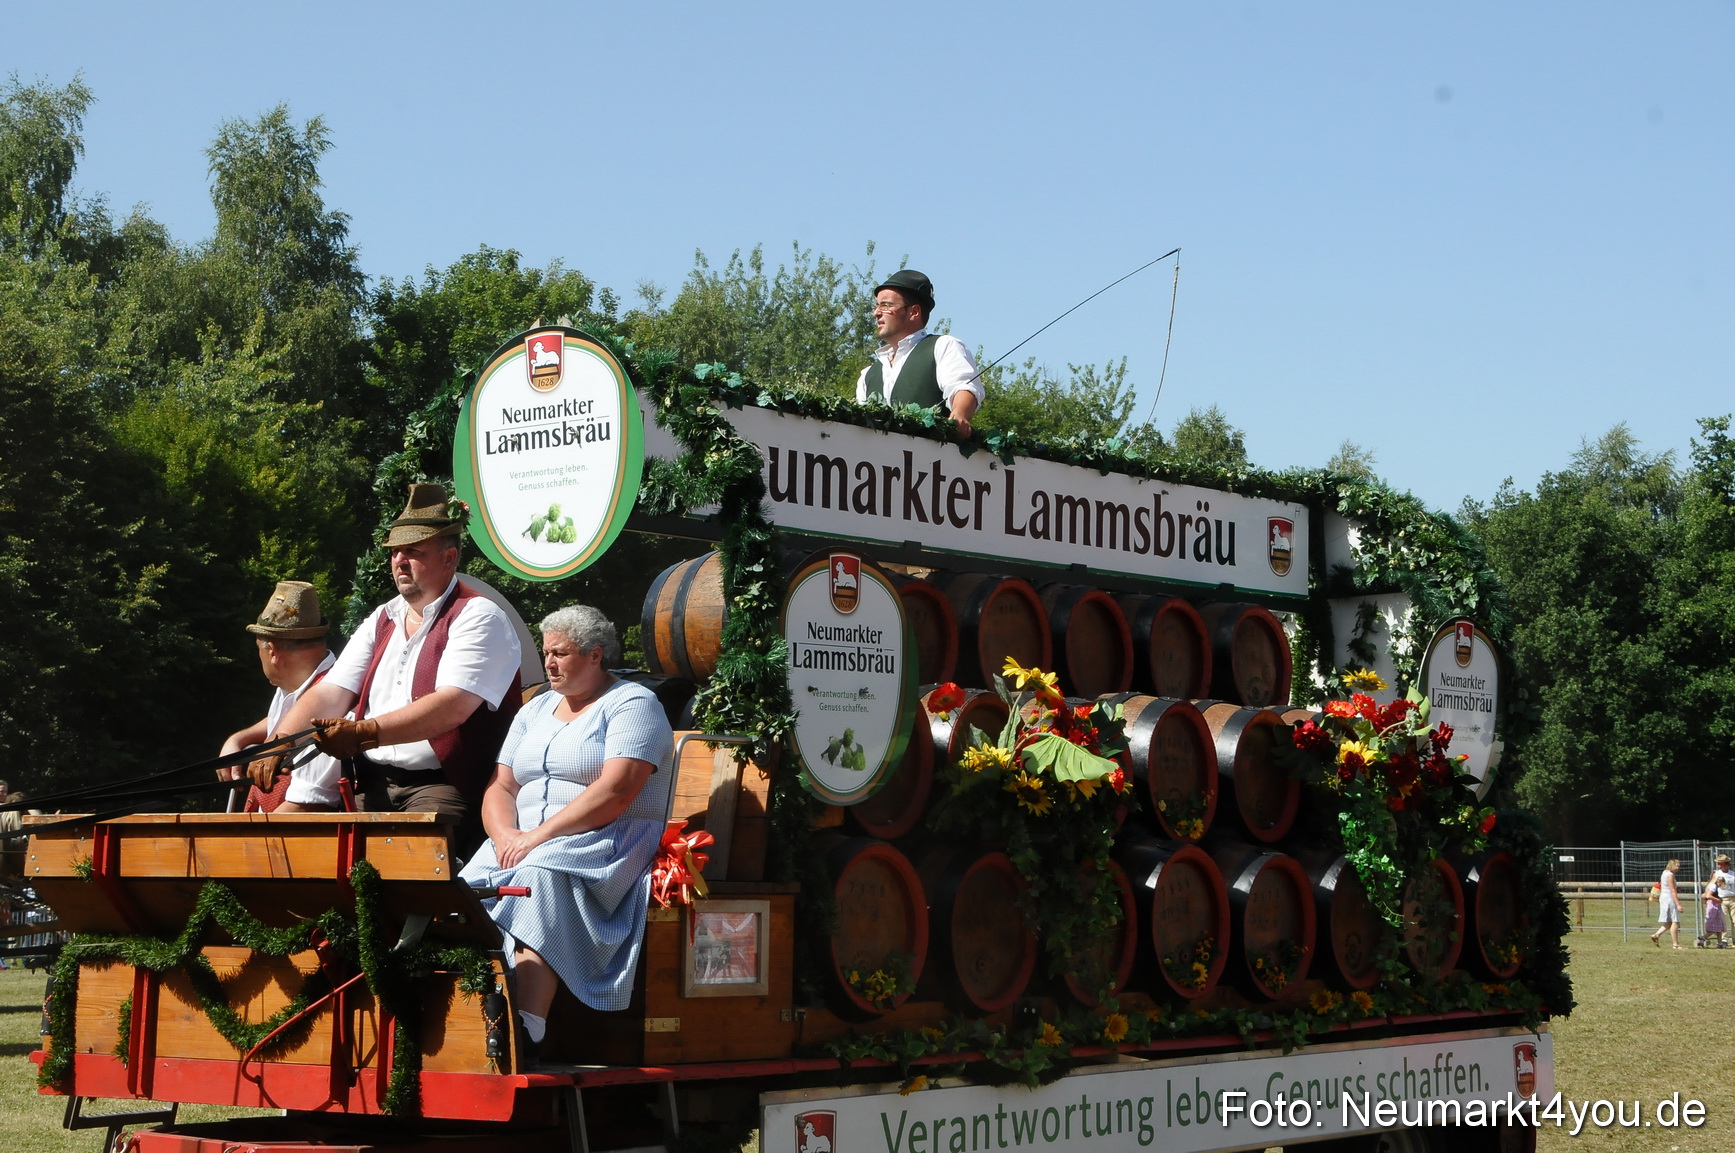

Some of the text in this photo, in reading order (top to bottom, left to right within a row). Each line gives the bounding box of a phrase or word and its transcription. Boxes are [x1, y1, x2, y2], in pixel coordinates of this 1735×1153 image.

[537, 378, 555, 387] 1628
[502, 398, 594, 425] Neumarkter
[485, 417, 611, 455] Lammsbräu
[509, 464, 588, 479] Verantwortung leben.
[518, 478, 580, 491] Genuss schaffen.
[768, 446, 1237, 566] umarkter Lammsbräu
[807, 621, 883, 645] Neumarkter
[792, 642, 895, 674] Lammsbräu
[1440, 672, 1486, 690] Neumarkter
[819, 702, 870, 713] Genuss schaffen.
[1431, 687, 1493, 713] Lammsbräu
[880, 1051, 1490, 1153] Verantwortung leben Genuss schaffen.
